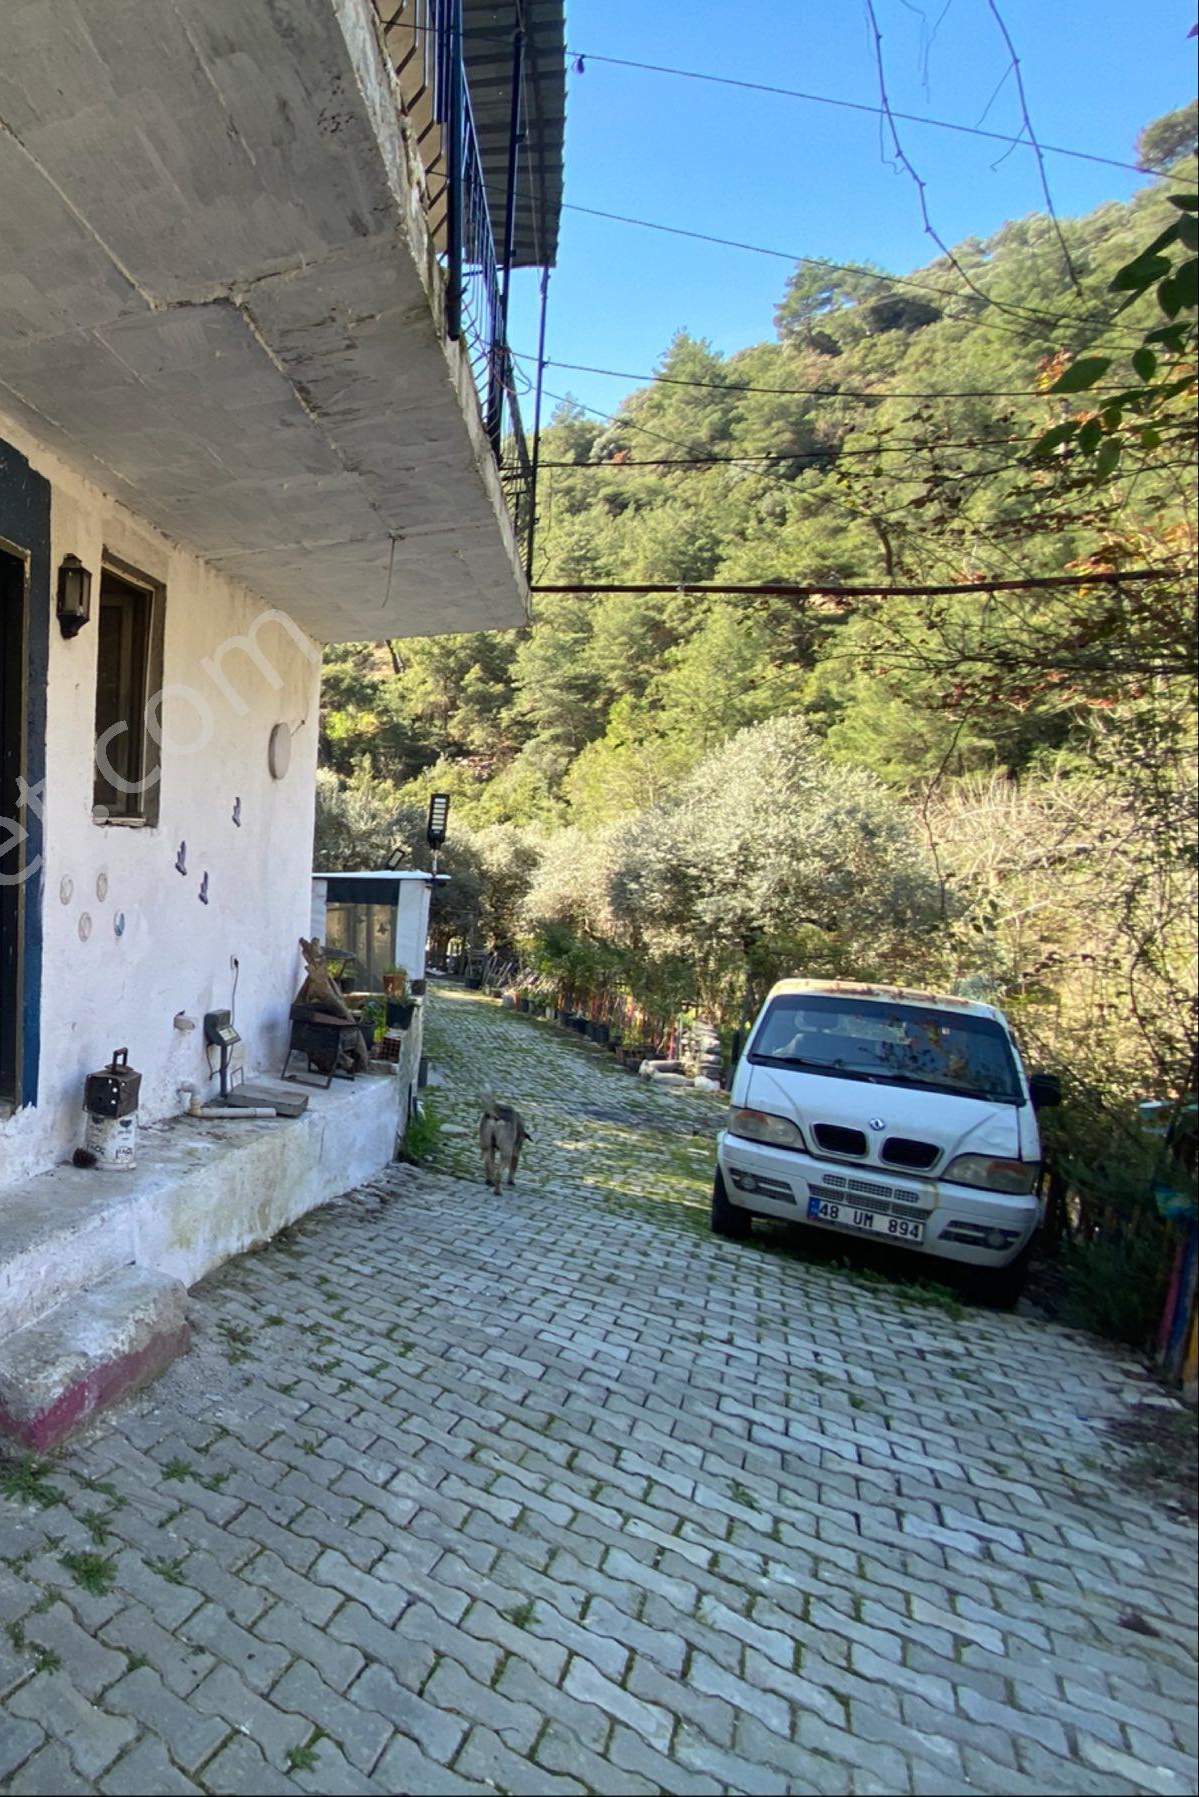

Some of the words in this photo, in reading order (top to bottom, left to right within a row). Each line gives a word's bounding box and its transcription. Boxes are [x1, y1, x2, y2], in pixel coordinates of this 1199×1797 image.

[820, 1203, 839, 1219] 48
[853, 1210, 874, 1228] UM
[888, 1219, 919, 1238] 894
